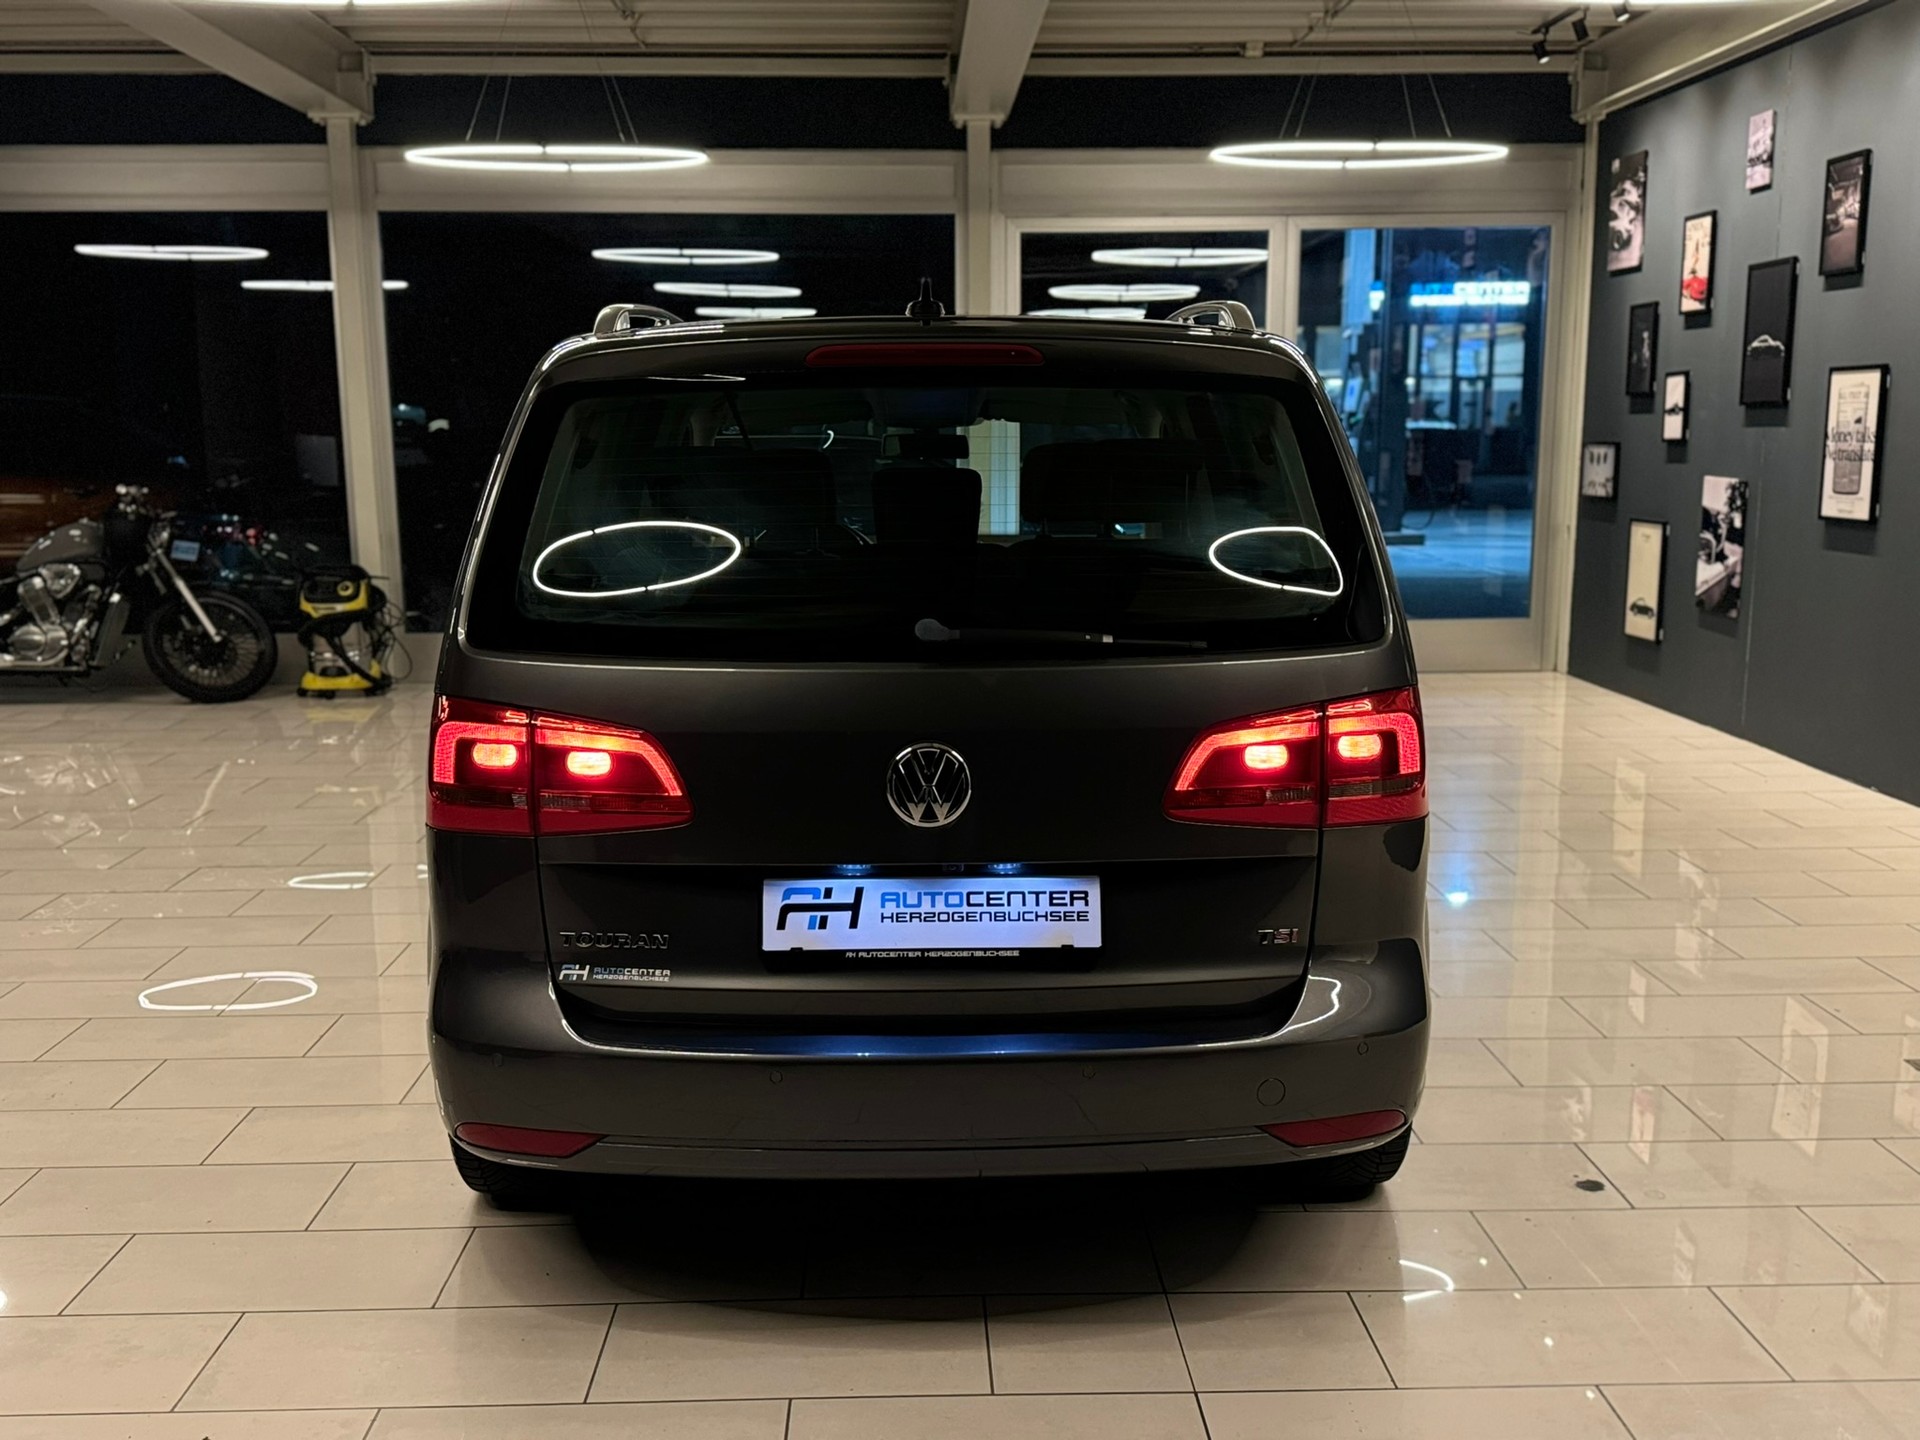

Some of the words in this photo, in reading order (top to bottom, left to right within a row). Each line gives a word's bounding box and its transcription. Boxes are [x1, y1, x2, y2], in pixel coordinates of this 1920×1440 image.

[880, 890, 1089, 908] AUTOCENTER
[880, 911, 1089, 923] HERZOGENBUCHSEE
[560, 932, 668, 949] TOURAN
[1258, 928, 1299, 944] TSI
[593, 967, 671, 976] AUTOCENTER
